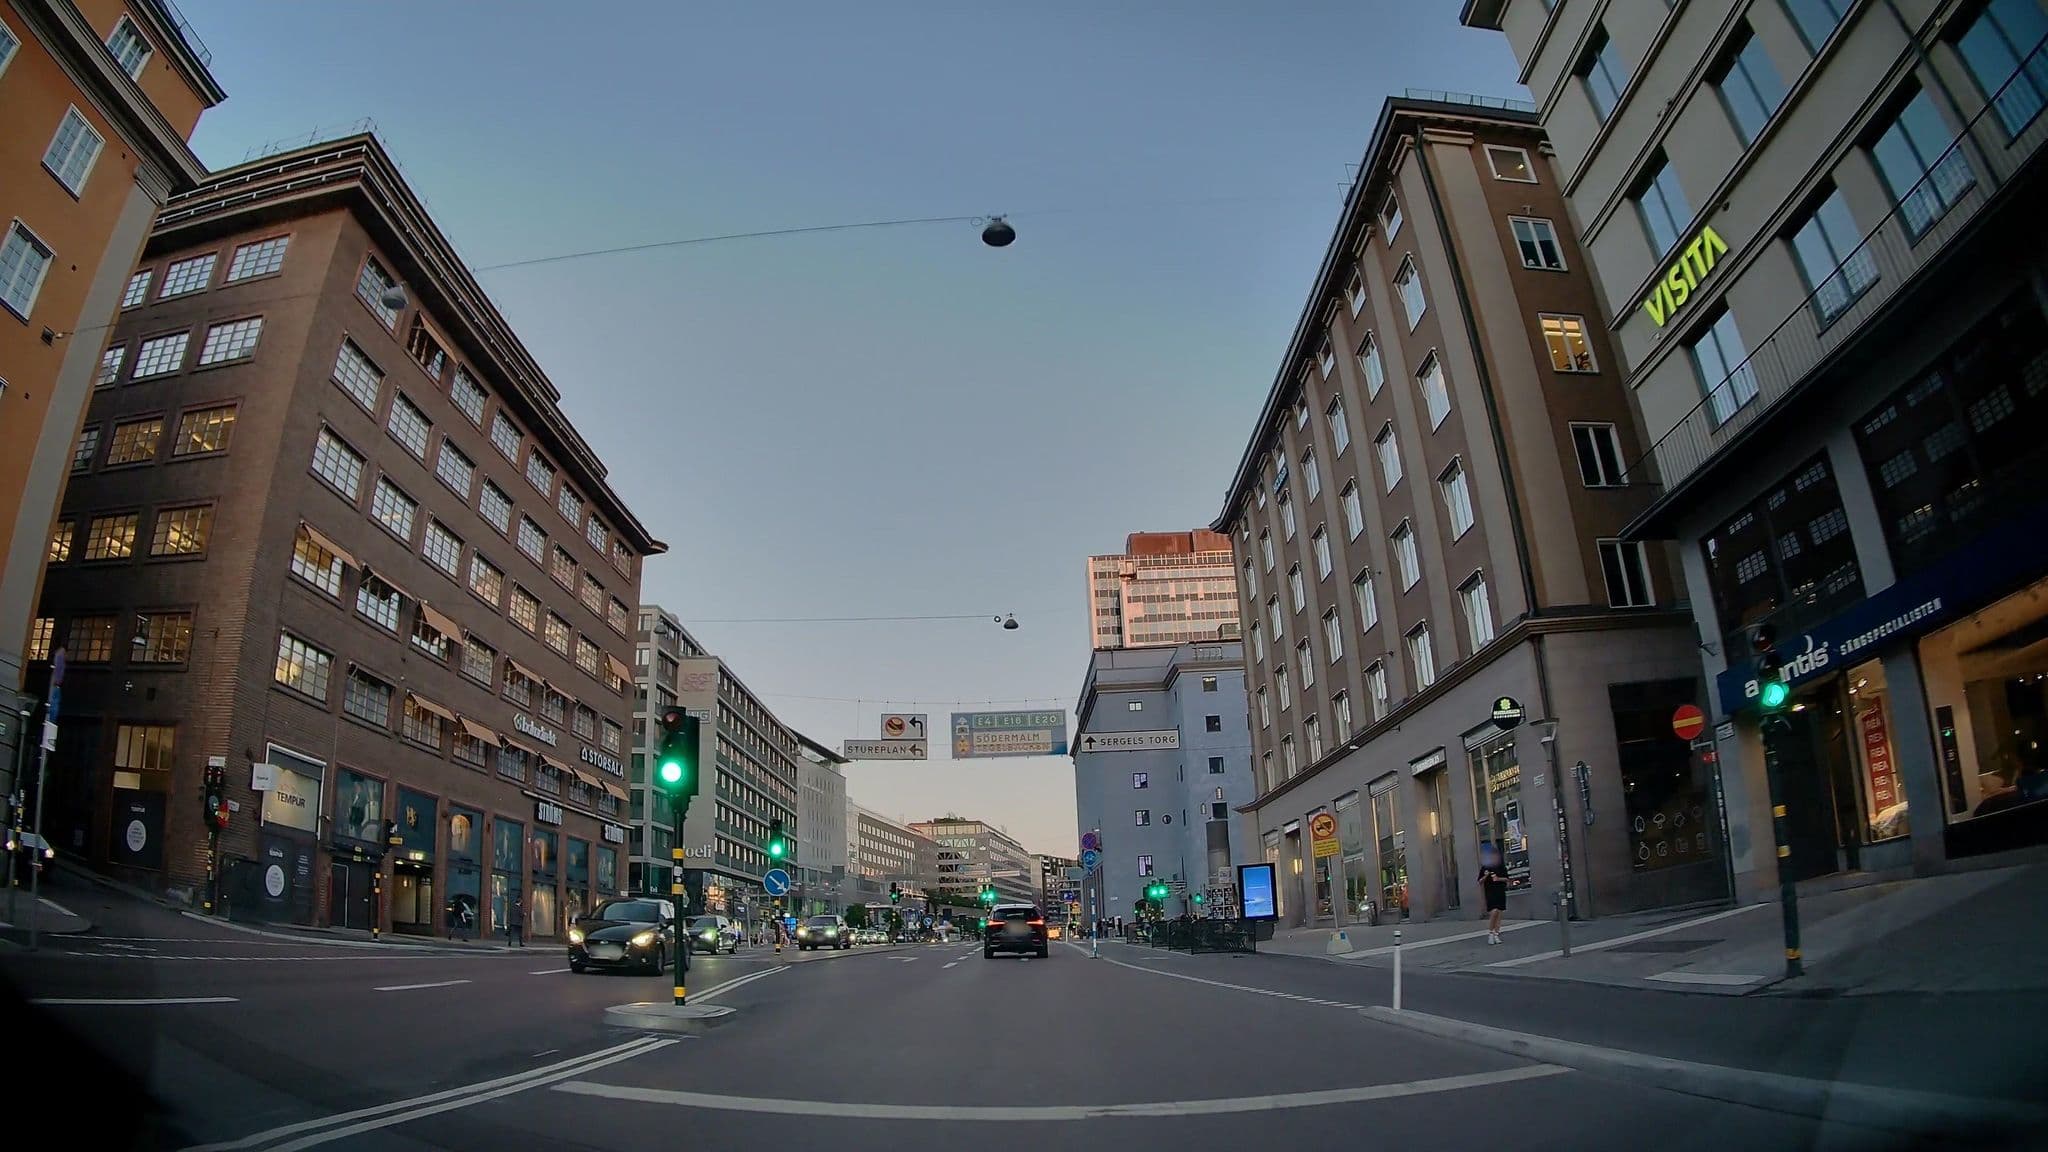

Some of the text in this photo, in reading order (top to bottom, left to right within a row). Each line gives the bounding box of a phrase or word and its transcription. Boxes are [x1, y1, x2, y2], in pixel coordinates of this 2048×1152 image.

[1644, 225, 1729, 327] VISITA
[1744, 636, 1829, 698] antis
[977, 716, 991, 726] E4
[1035, 714, 1057, 724] E20
[976, 732, 1040, 743] SÖDERMALM
[1100, 735, 1176, 746] SERGELS TORG
[847, 745, 907, 754] STUREPLAN
[589, 751, 624, 779] STORSALA
[277, 791, 306, 809] TEMPUR
